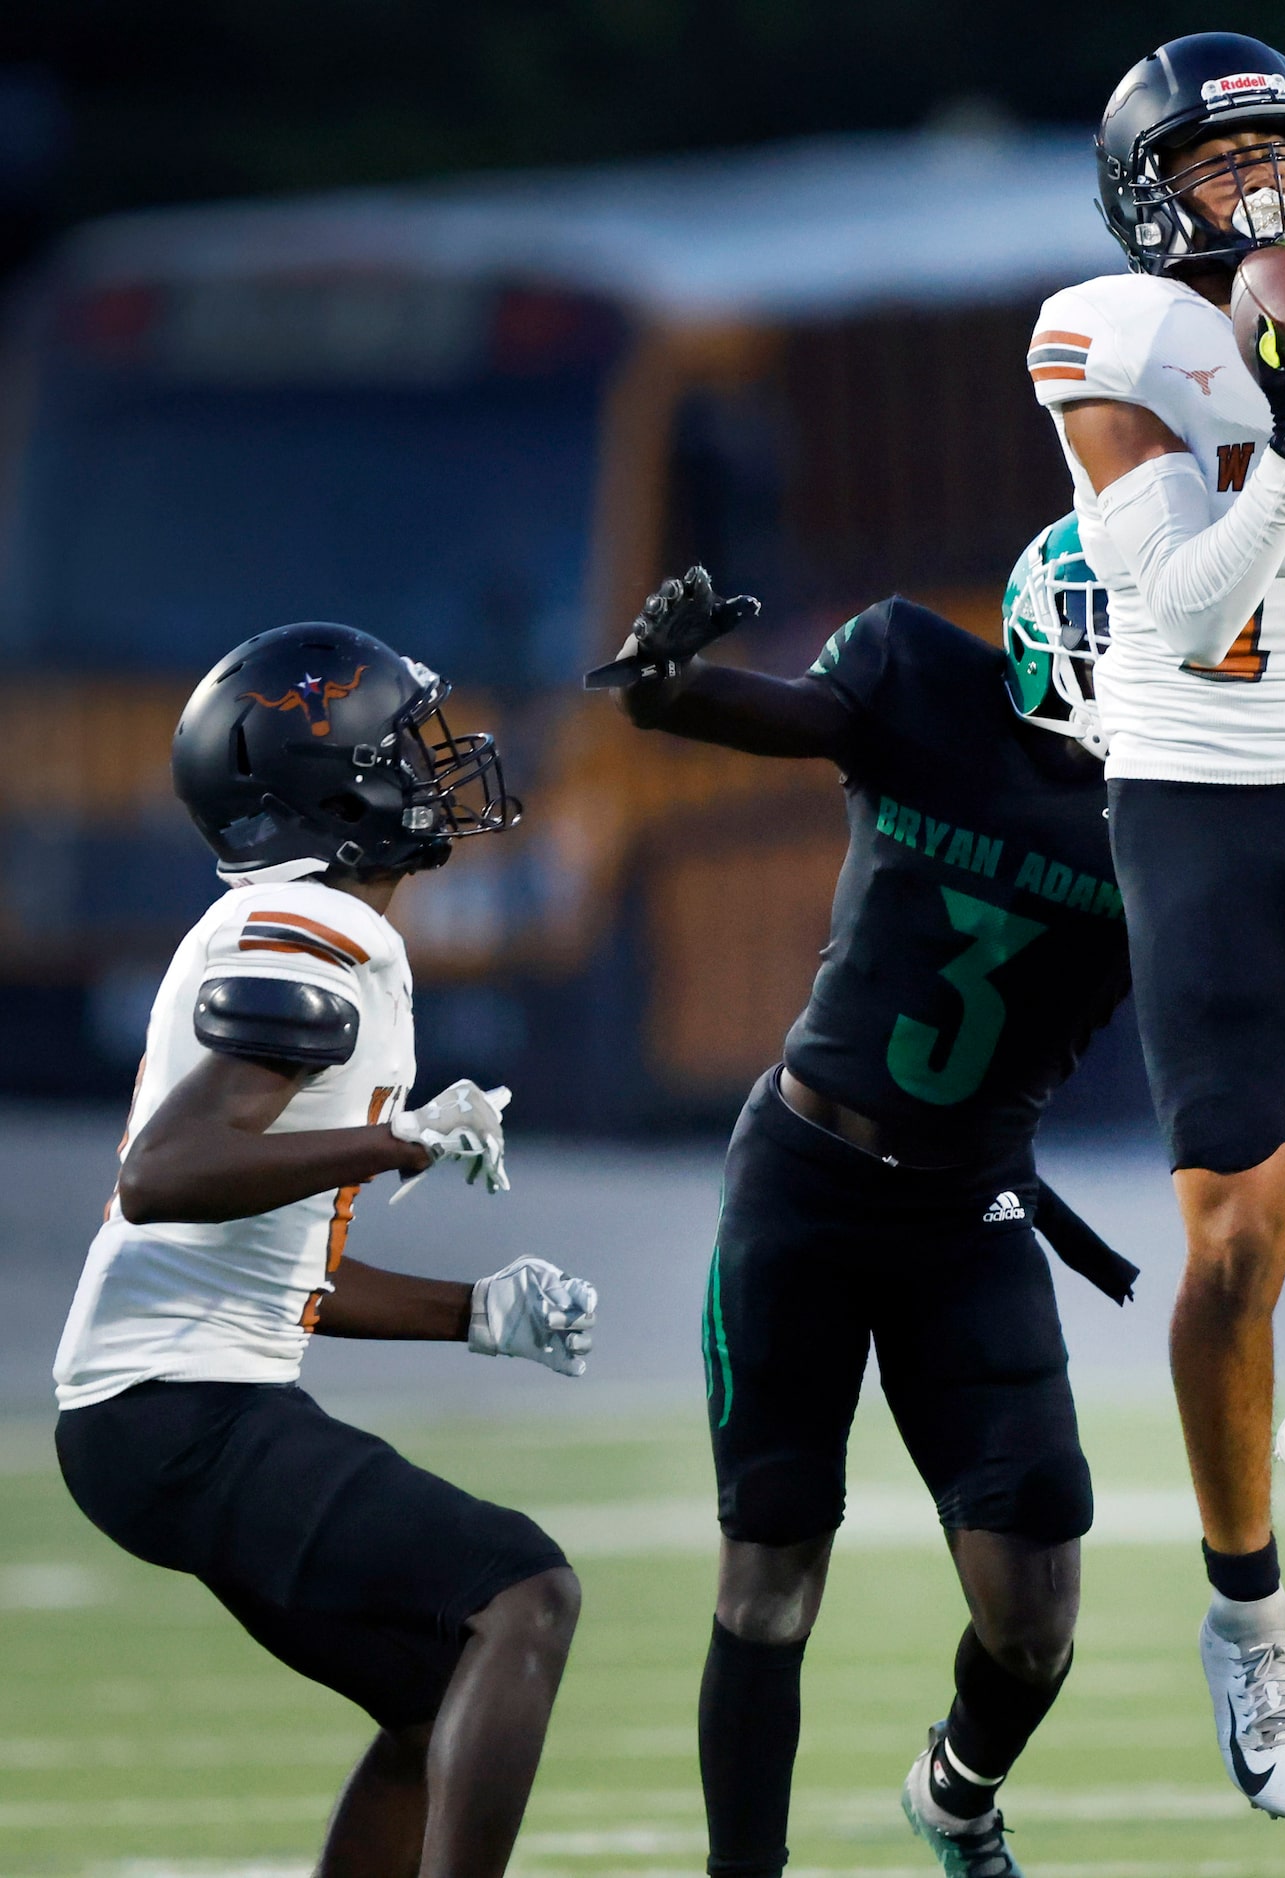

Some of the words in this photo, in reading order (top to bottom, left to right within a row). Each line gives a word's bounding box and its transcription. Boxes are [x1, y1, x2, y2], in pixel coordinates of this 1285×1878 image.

[1220, 76, 1266, 91] Riddell
[876, 795, 1004, 879] BRYAN
[886, 884, 1049, 1106] 3
[983, 1205, 1026, 1223] adidas
